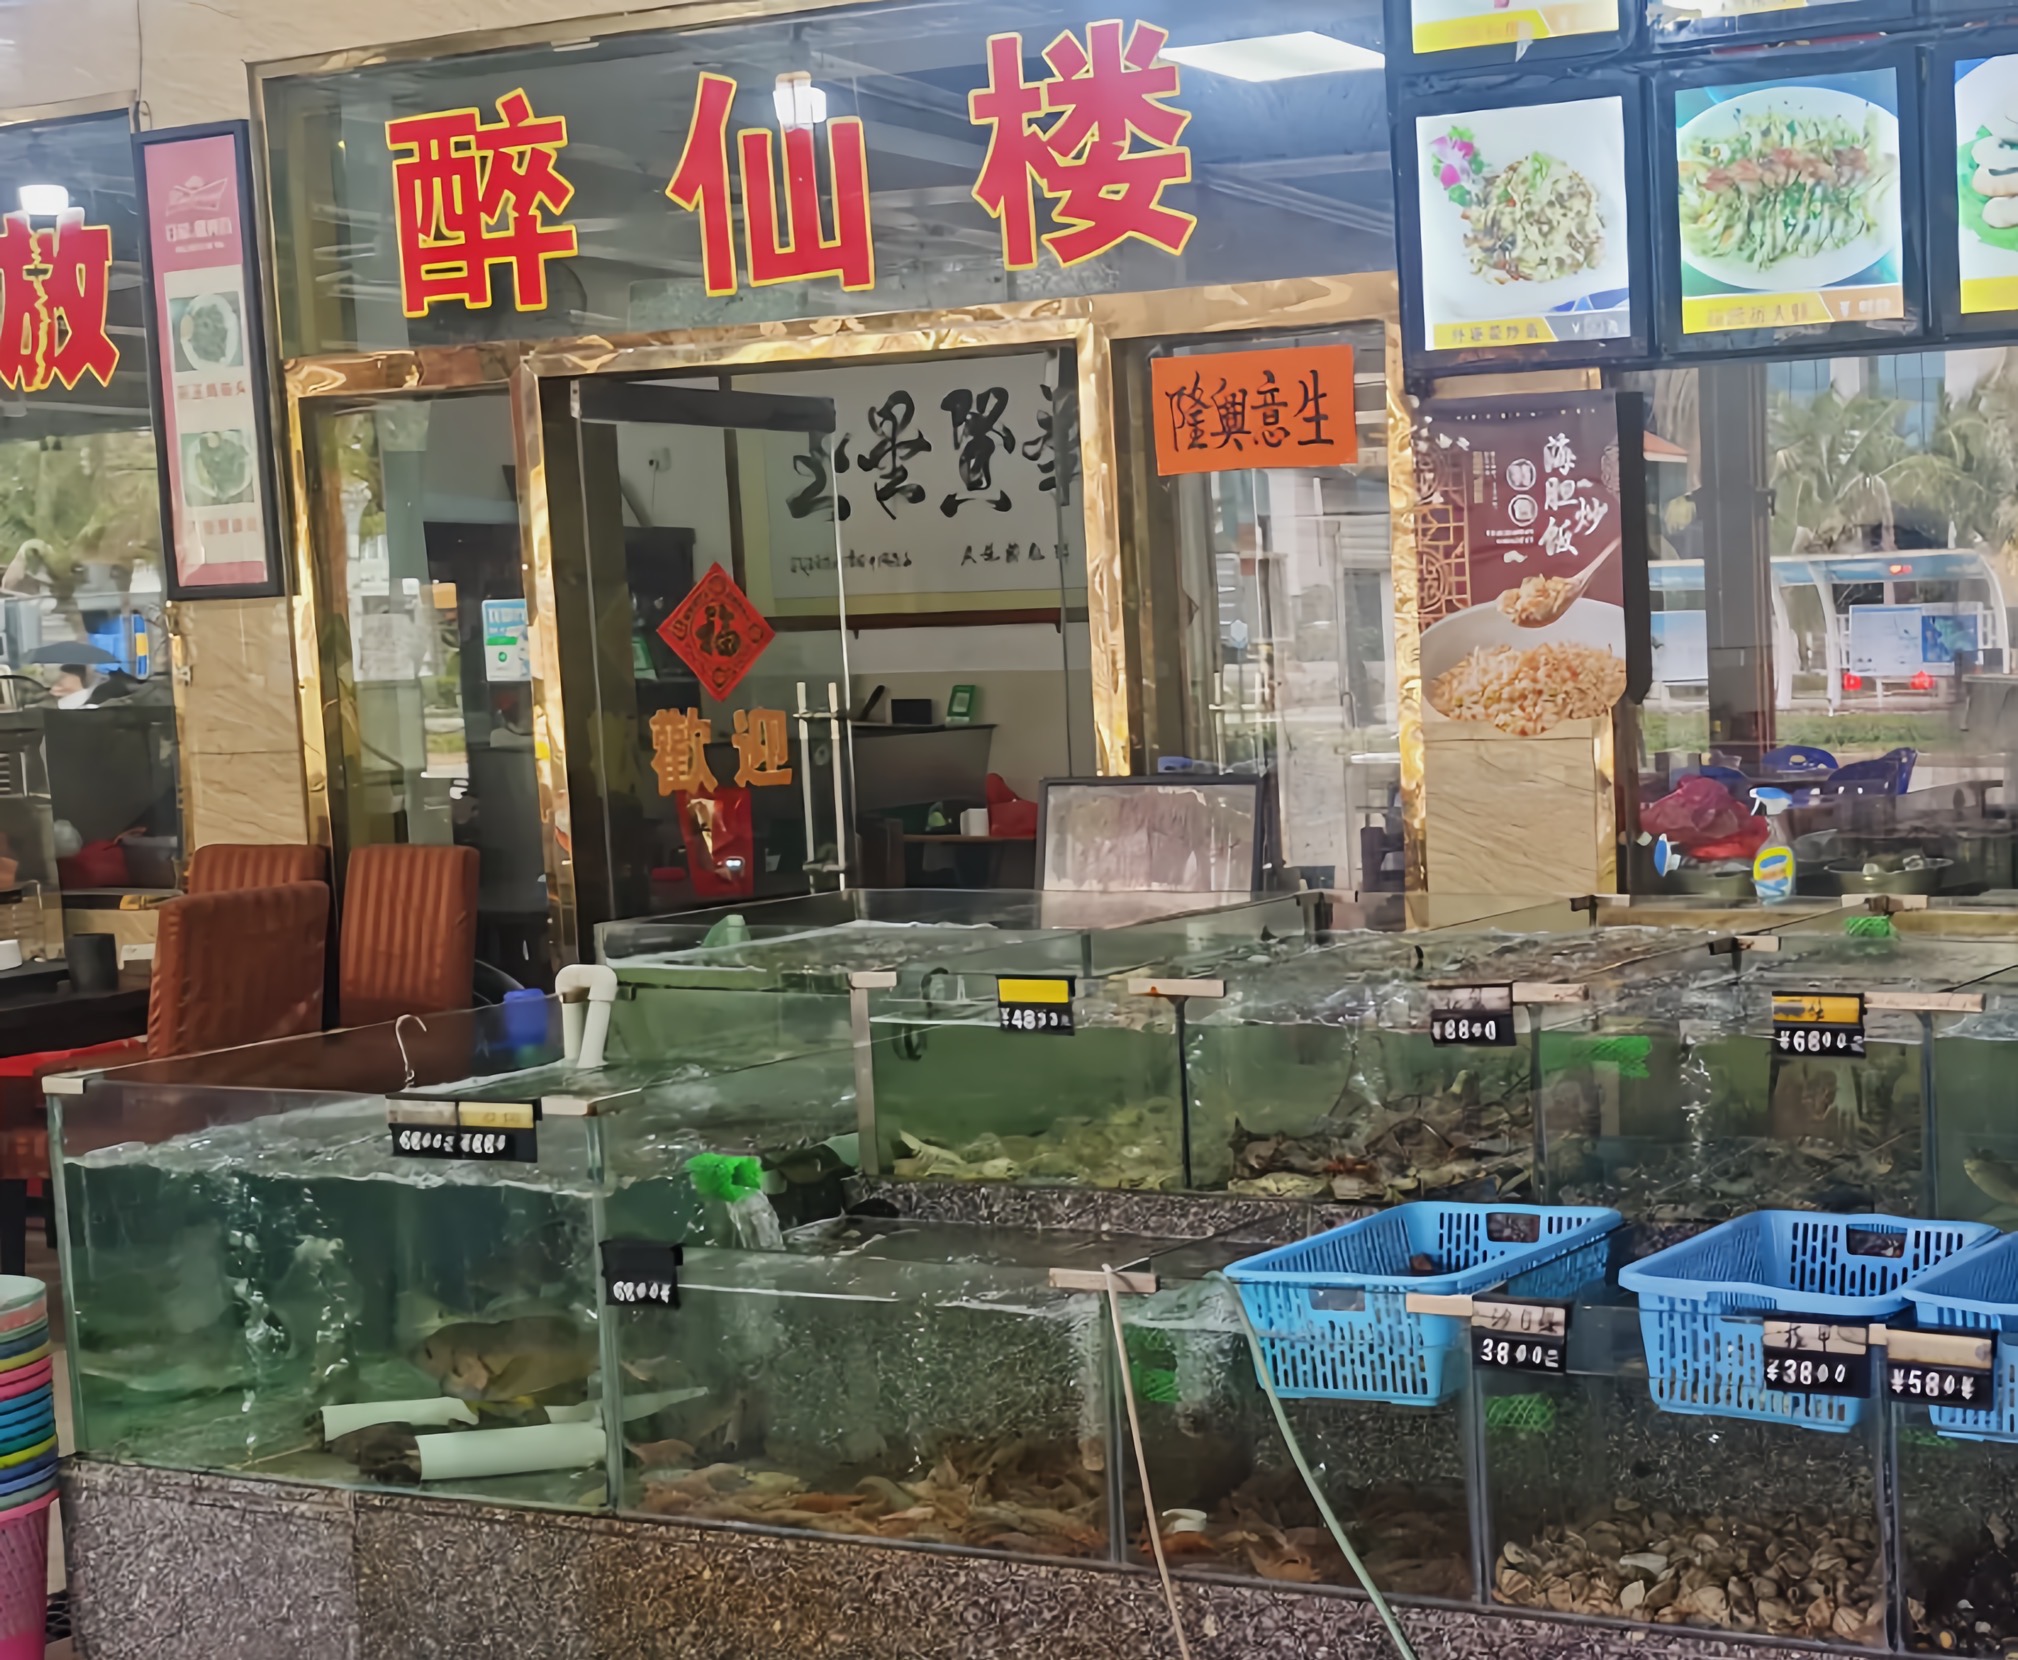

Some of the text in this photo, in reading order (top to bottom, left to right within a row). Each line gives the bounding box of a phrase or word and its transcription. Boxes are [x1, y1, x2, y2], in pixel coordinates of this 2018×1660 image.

[386, 20, 1197, 320] 醉仙楼
[695, 603, 741, 657] 福
